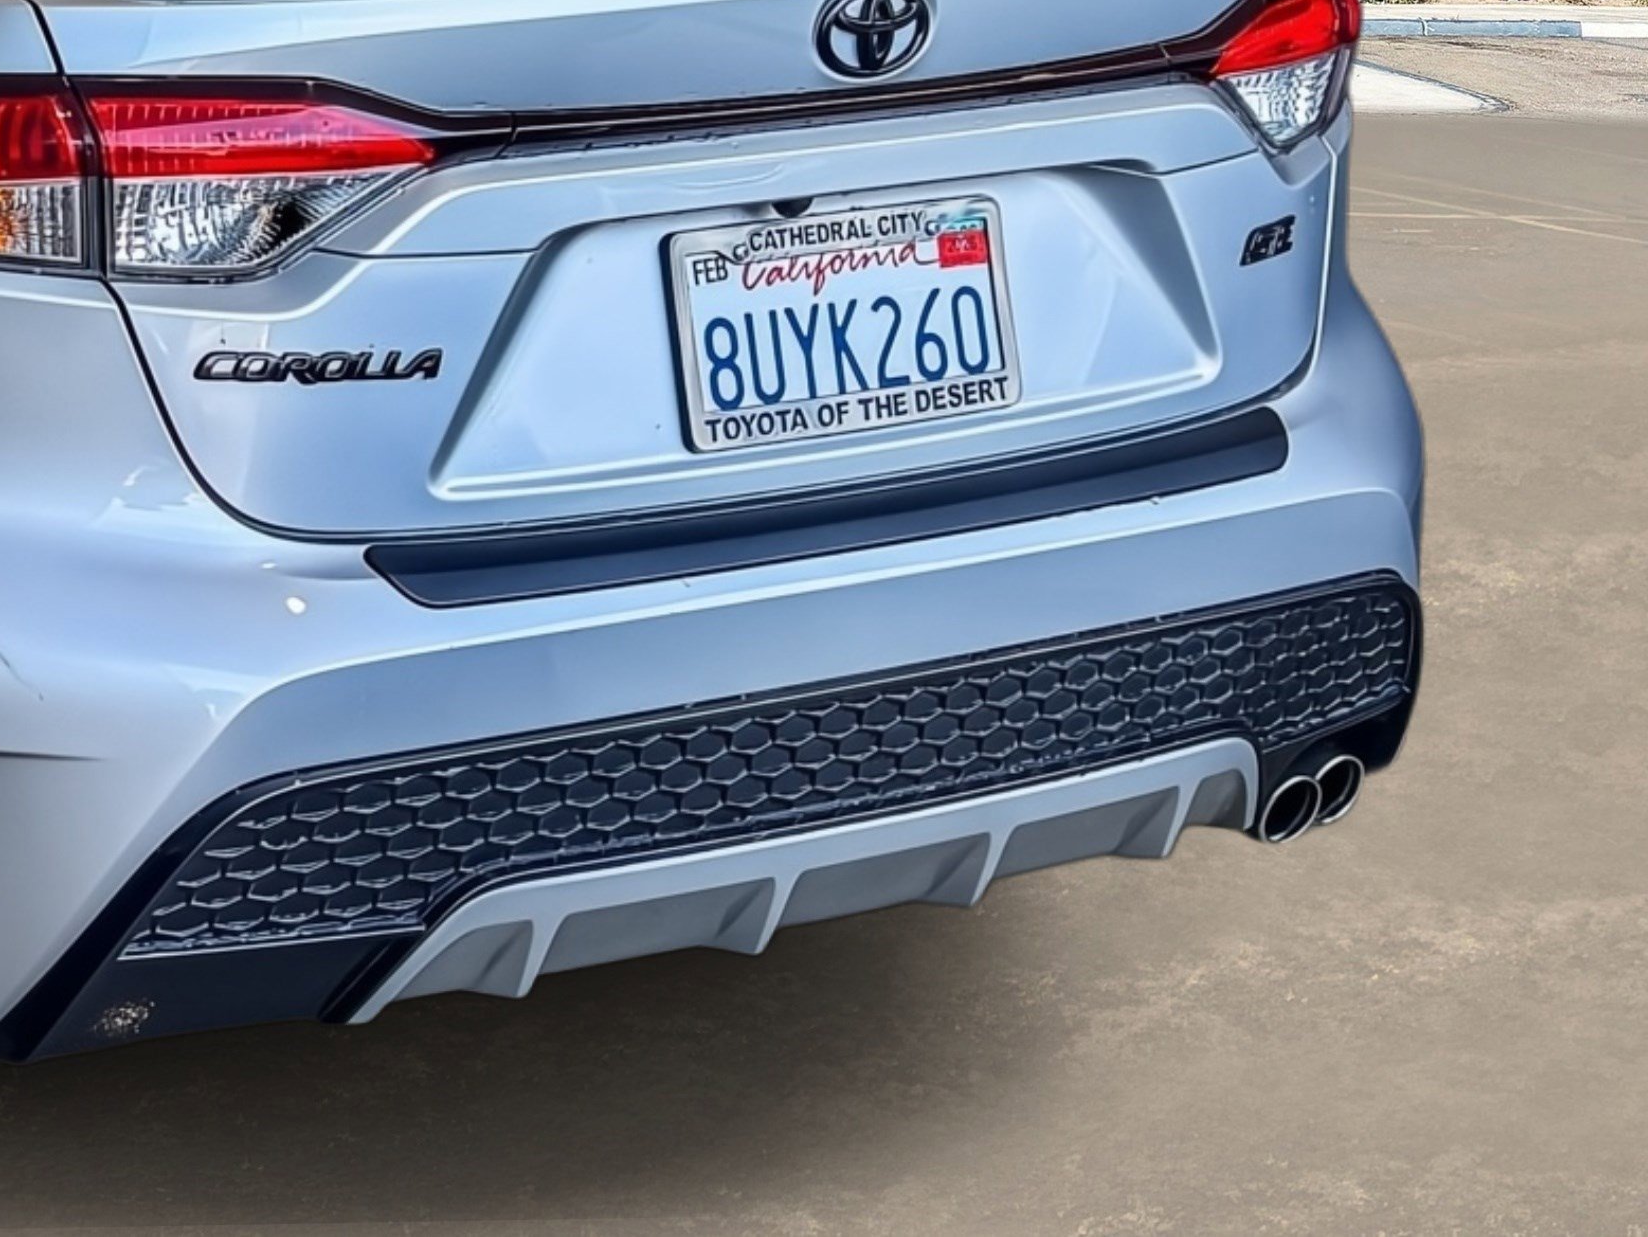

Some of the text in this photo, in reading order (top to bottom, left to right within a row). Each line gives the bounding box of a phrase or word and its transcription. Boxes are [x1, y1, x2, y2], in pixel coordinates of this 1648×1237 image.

[749, 211, 923, 252] CATHEDRAL CITY
[692, 256, 728, 286] FEB
[741, 237, 919, 297] California
[193, 348, 443, 384] COROLLA
[704, 285, 990, 412] 8UYK260
[704, 376, 1009, 443] TOYOTA OF THE DESERT
